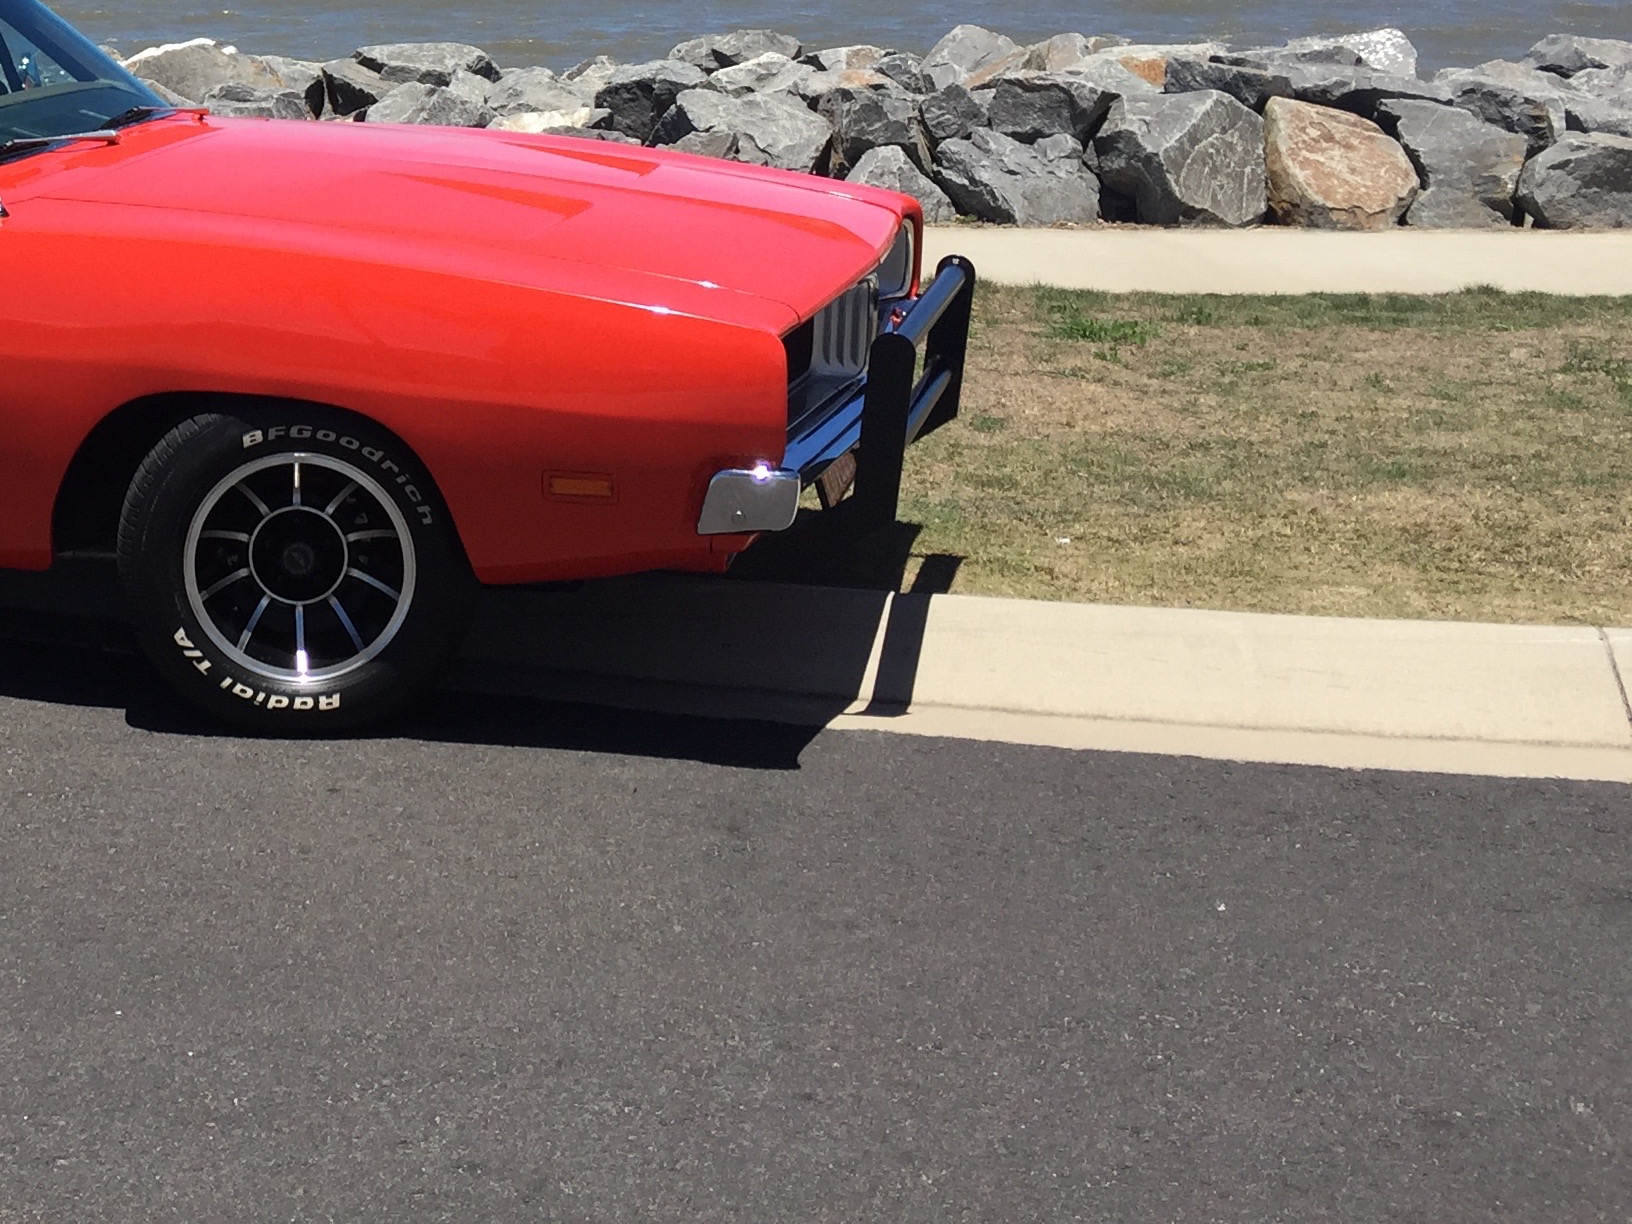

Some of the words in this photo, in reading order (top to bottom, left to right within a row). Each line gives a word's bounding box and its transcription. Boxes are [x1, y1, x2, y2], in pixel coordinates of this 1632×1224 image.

[241, 424, 434, 526] BFGoodrich
[173, 626, 213, 676] T/A
[220, 676, 341, 711] Radial
